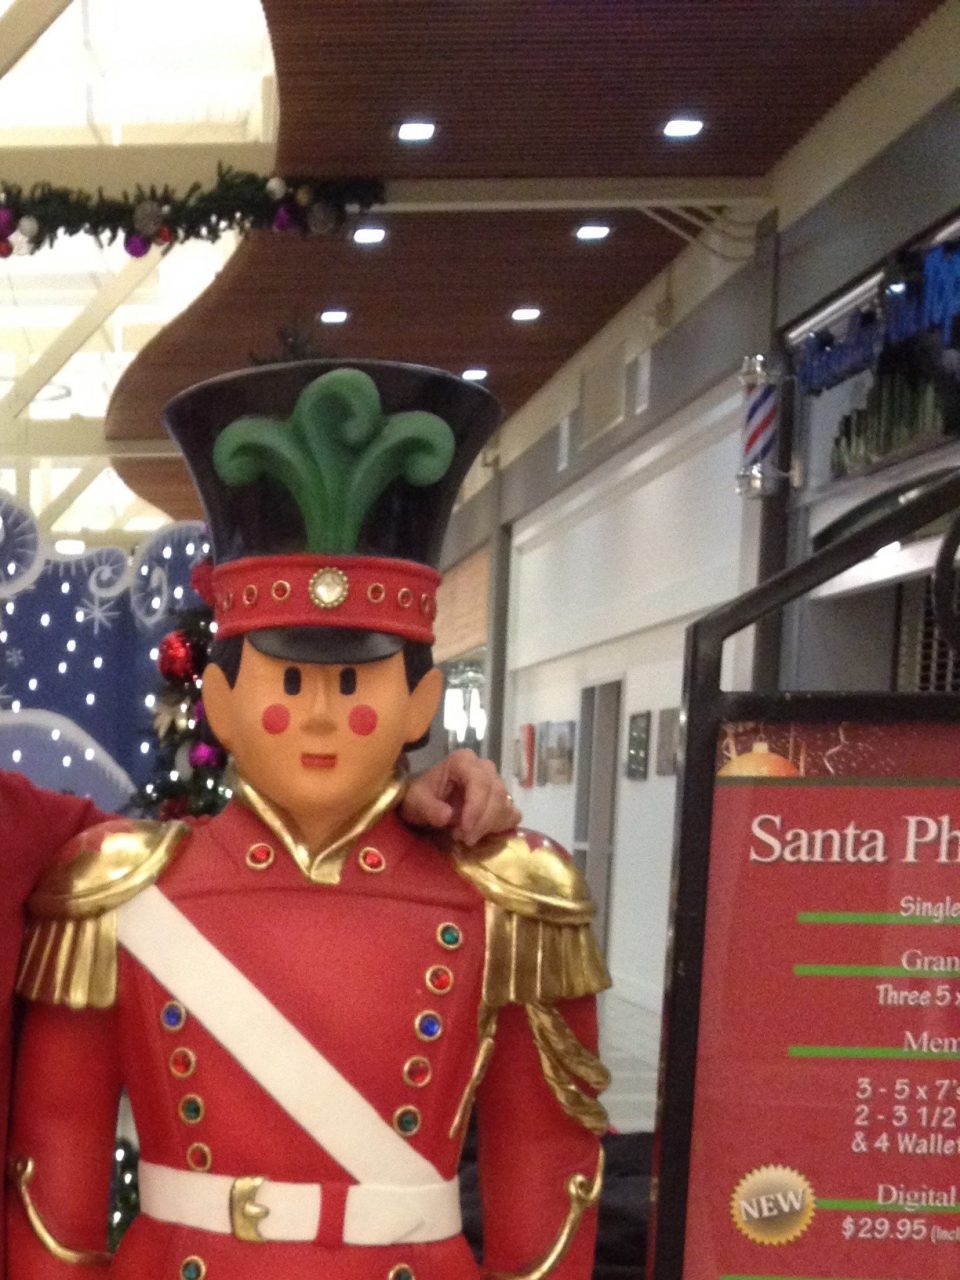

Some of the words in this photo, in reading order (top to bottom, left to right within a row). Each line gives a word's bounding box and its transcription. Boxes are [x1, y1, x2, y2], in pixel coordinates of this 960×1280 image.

[750, 814, 888, 863] Santa
[900, 896, 960, 922] Single
[876, 984, 932, 1006] Three
[935, 985, 952, 1006] 5
[856, 1077, 872, 1099] 3
[894, 1079, 910, 1100] 5
[916, 1085, 928, 1100] x
[854, 1104, 869, 1125] 2
[892, 1105, 908, 1127] 3
[918, 1106, 956, 1127] 1/2
[851, 1131, 867, 1153] &
[873, 1132, 889, 1153] 4
[740, 1190, 805, 1222] NEW
[877, 1183, 957, 1212] Digital
[841, 1215, 928, 1240] $29.95
